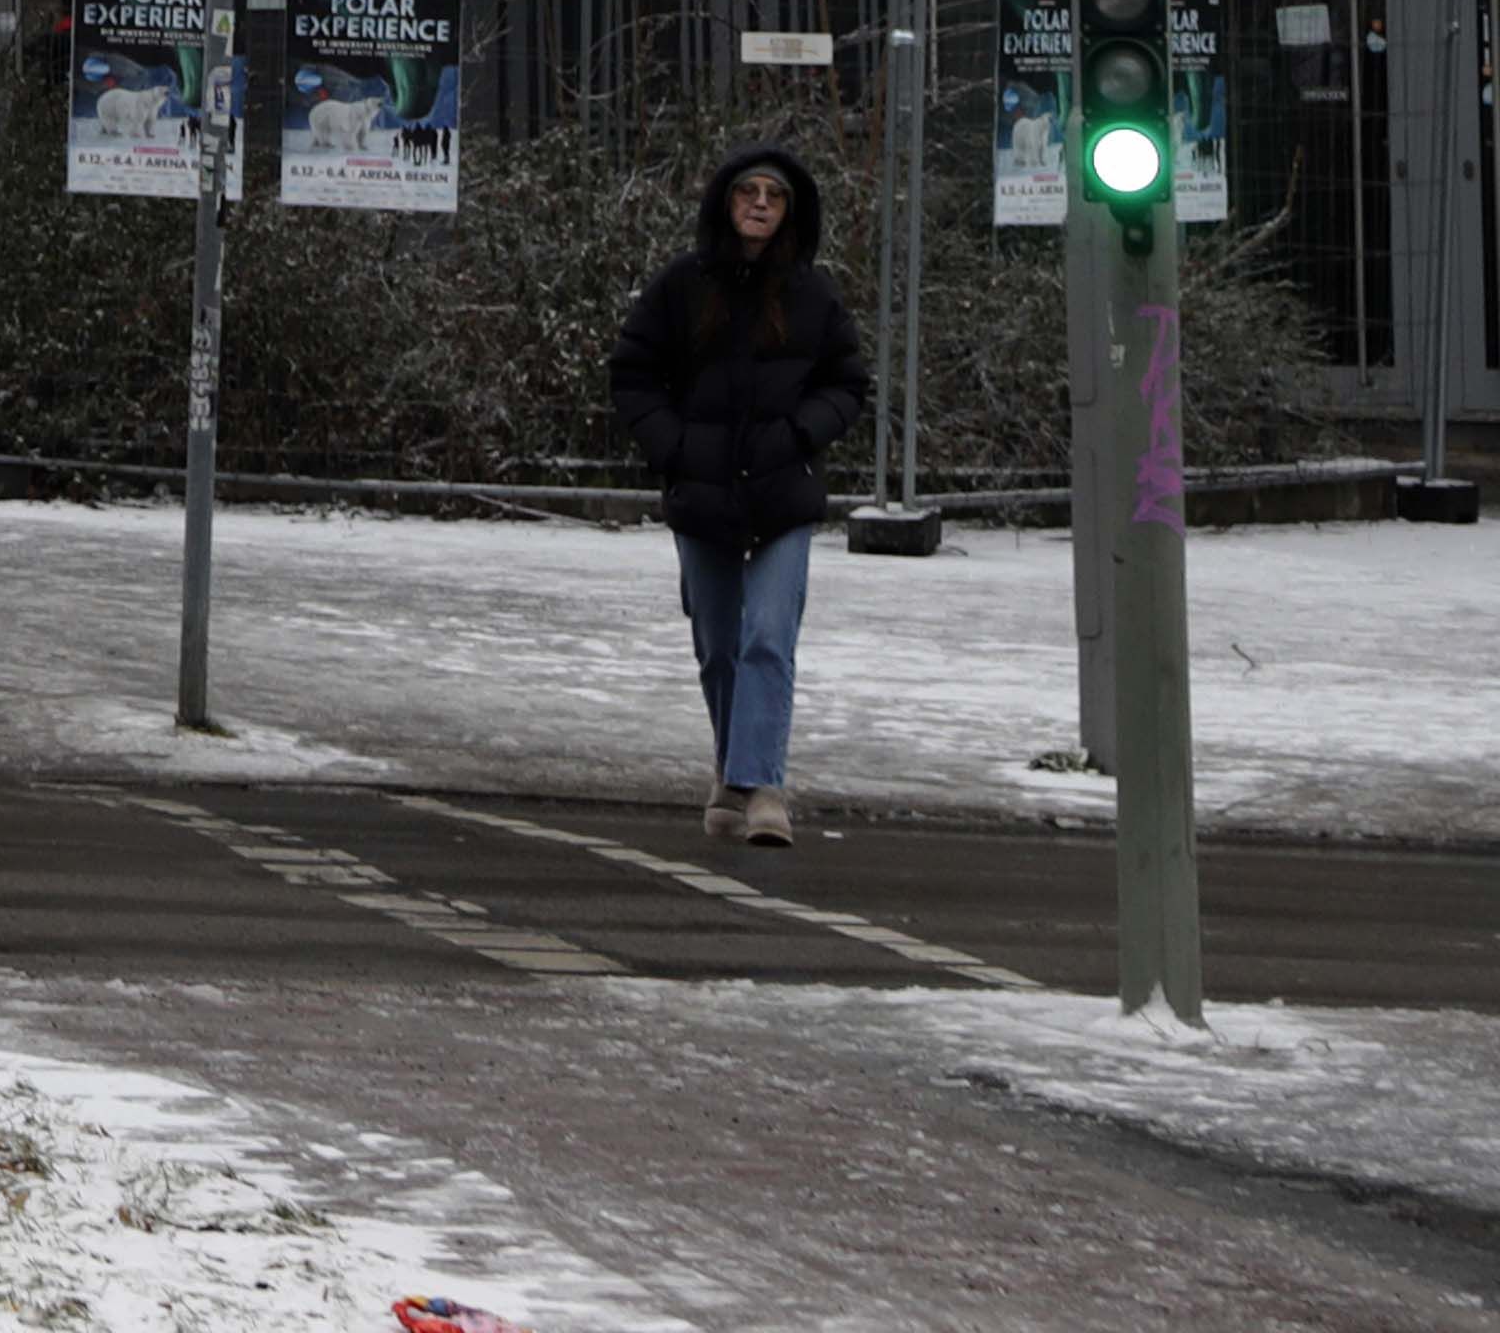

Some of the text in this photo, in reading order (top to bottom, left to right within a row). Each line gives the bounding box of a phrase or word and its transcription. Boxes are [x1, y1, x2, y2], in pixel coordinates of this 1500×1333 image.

[295, 14, 451, 43] EXPERIENCE
[1023, 8, 1070, 31] POLAR
[145, 156, 188, 170] ARENA
[358, 170, 401, 181] ARENA
[405, 172, 449, 183] BERLIN
